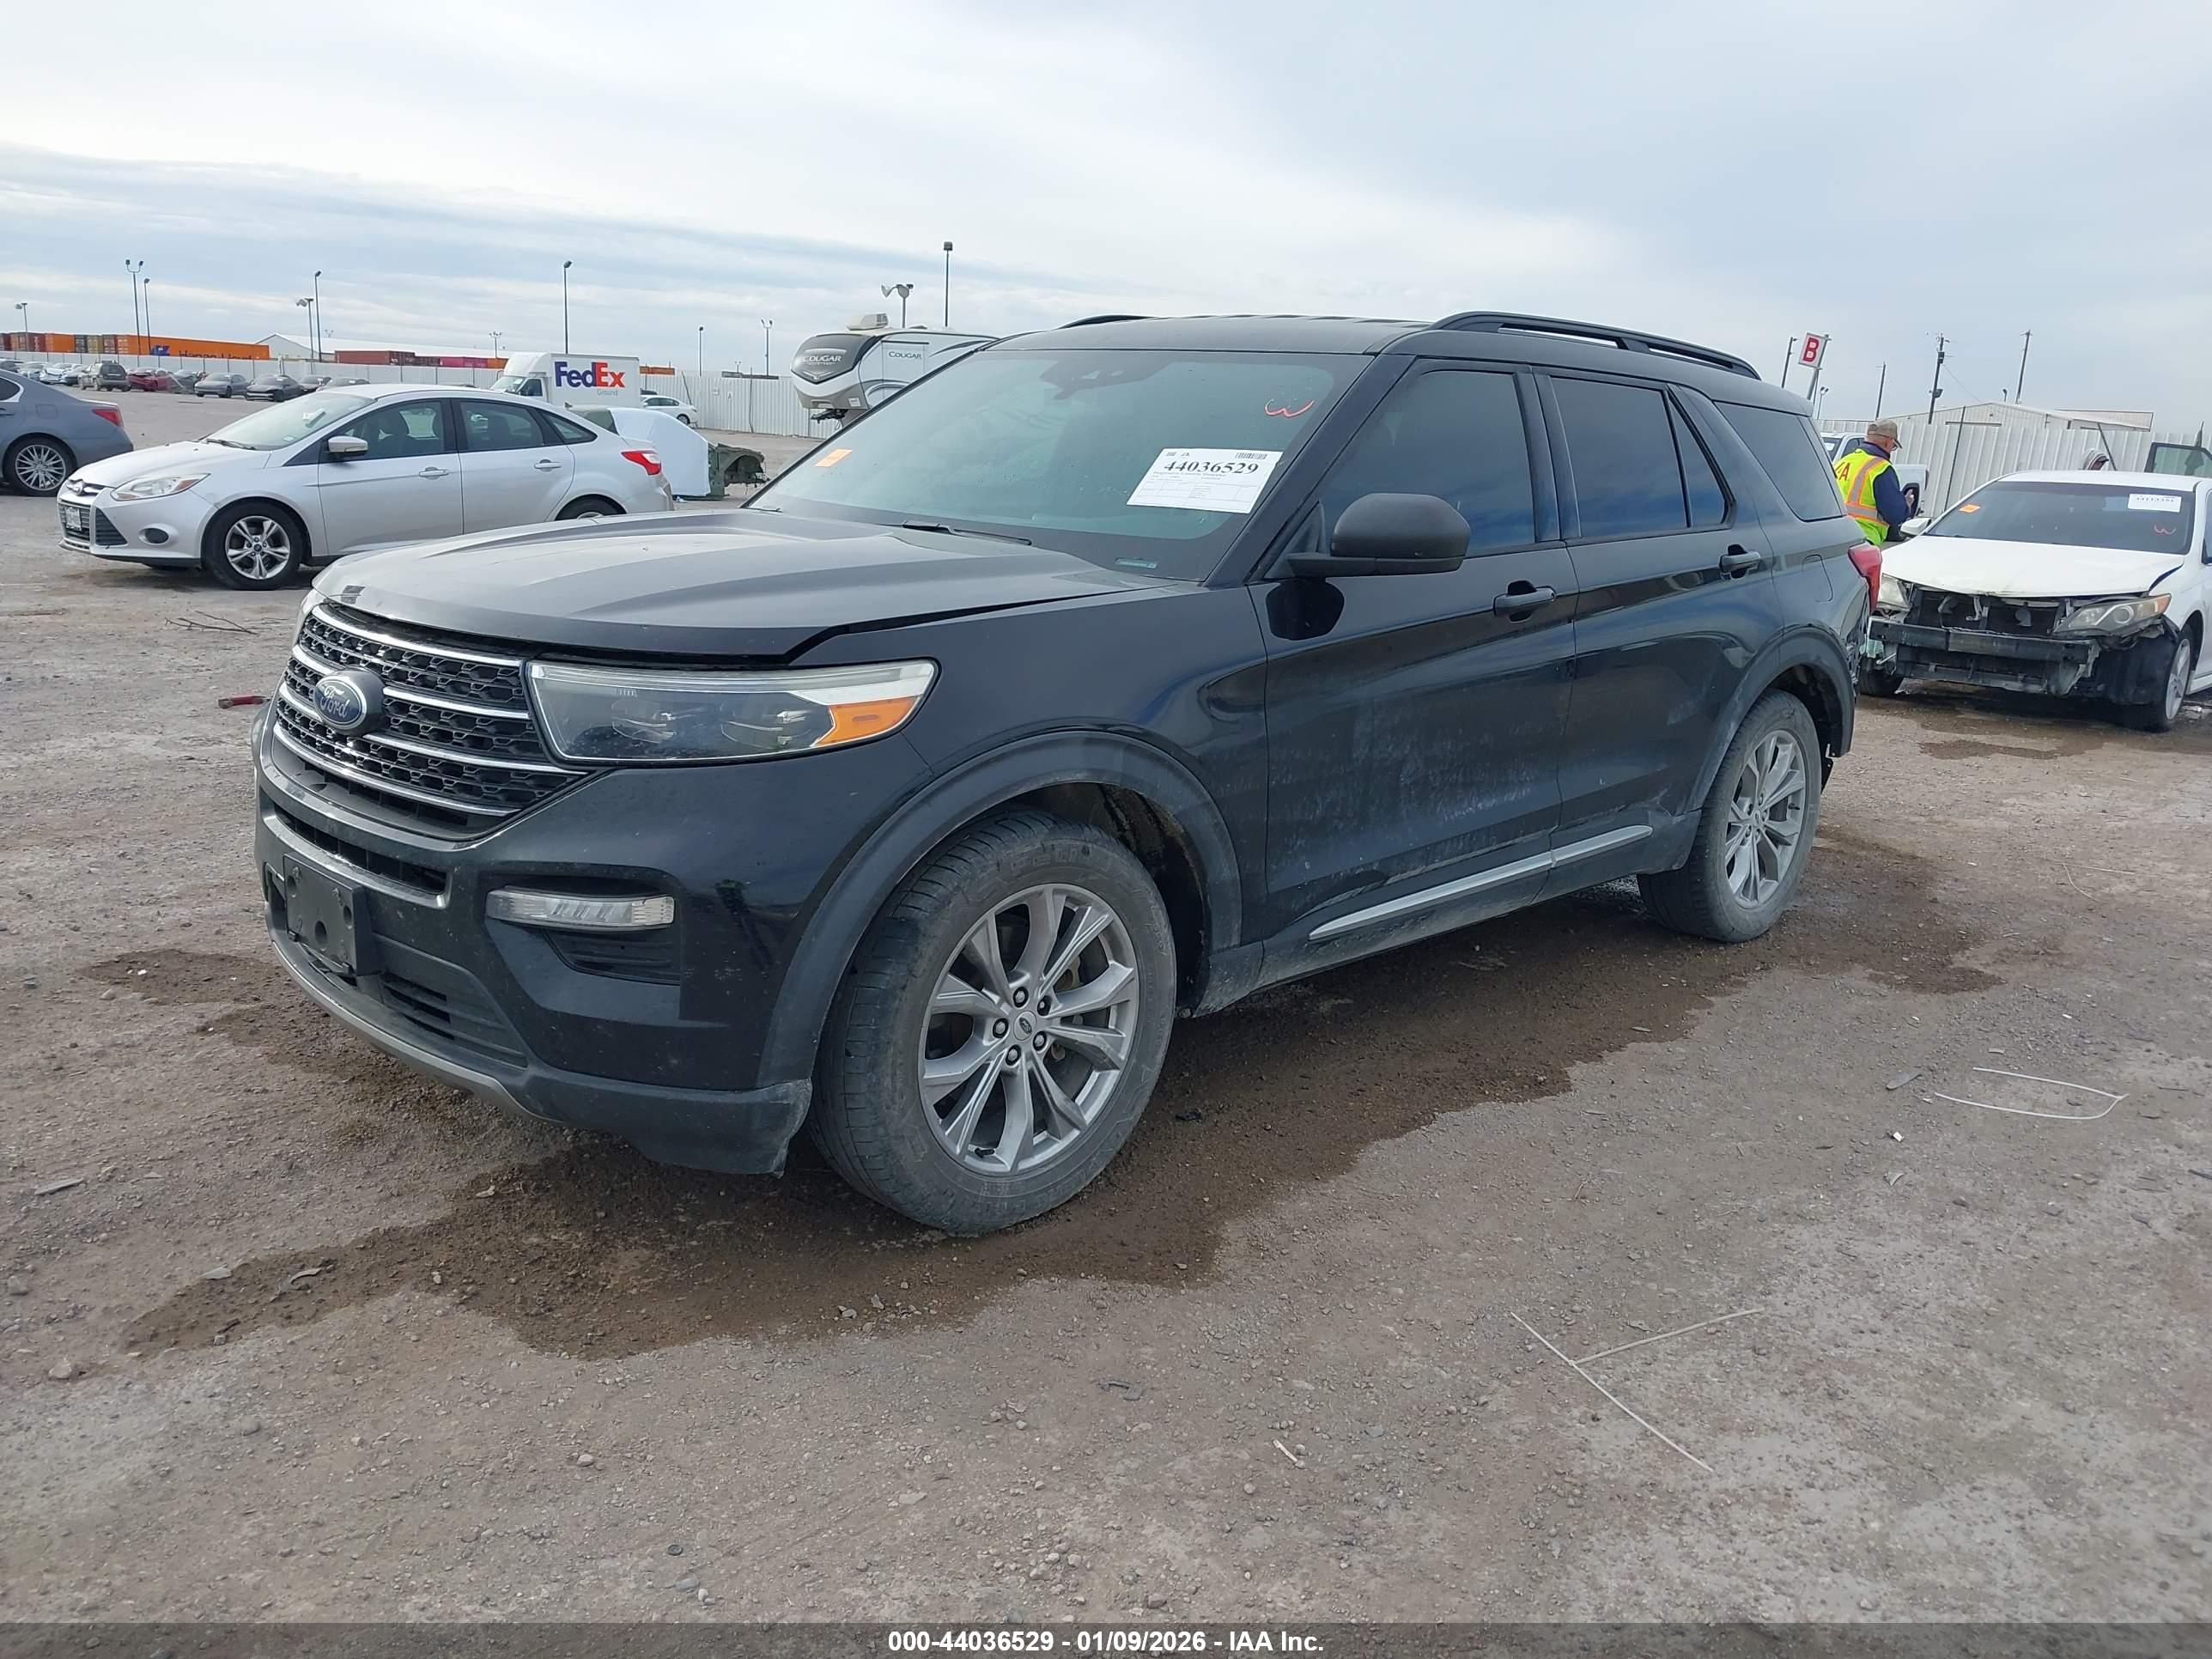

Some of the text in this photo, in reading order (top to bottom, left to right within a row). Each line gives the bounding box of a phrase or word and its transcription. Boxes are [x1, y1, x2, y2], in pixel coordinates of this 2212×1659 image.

[888, 350, 921, 359] COUGAR
[1802, 337, 1820, 362] B
[555, 362, 625, 387] FedEx
[1163, 460, 1260, 474] 44036529
[319, 685, 351, 718] Ford
